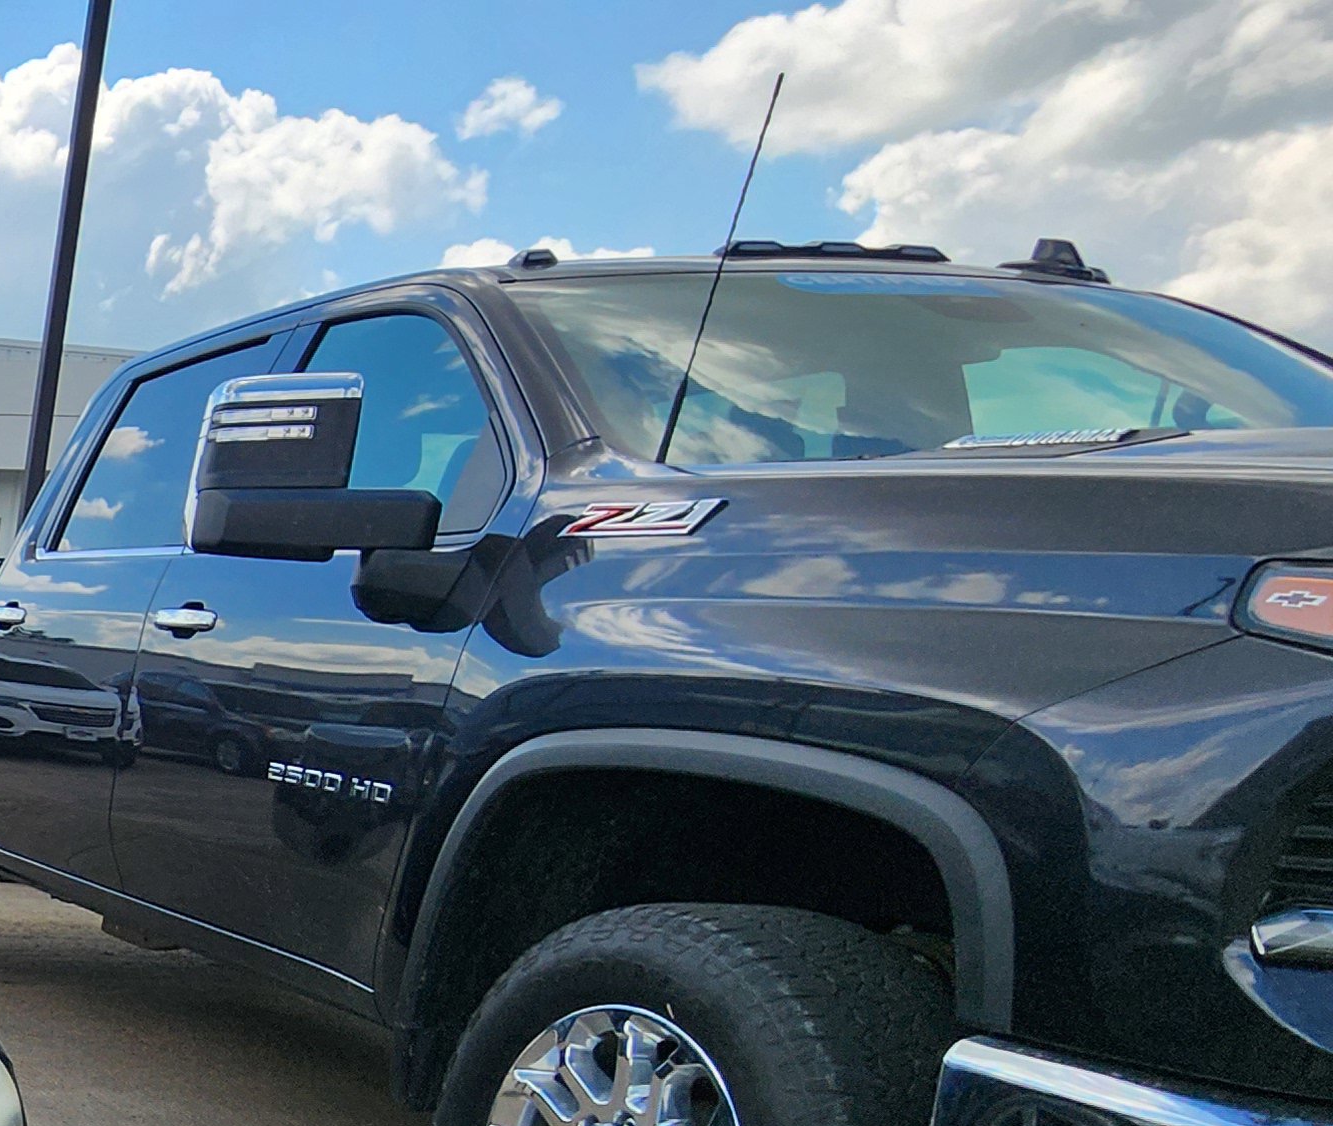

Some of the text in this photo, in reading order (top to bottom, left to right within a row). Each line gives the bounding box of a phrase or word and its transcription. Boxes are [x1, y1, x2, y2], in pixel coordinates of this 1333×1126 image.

[557, 498, 729, 538] Z71
[267, 761, 393, 803] 2500 HD
